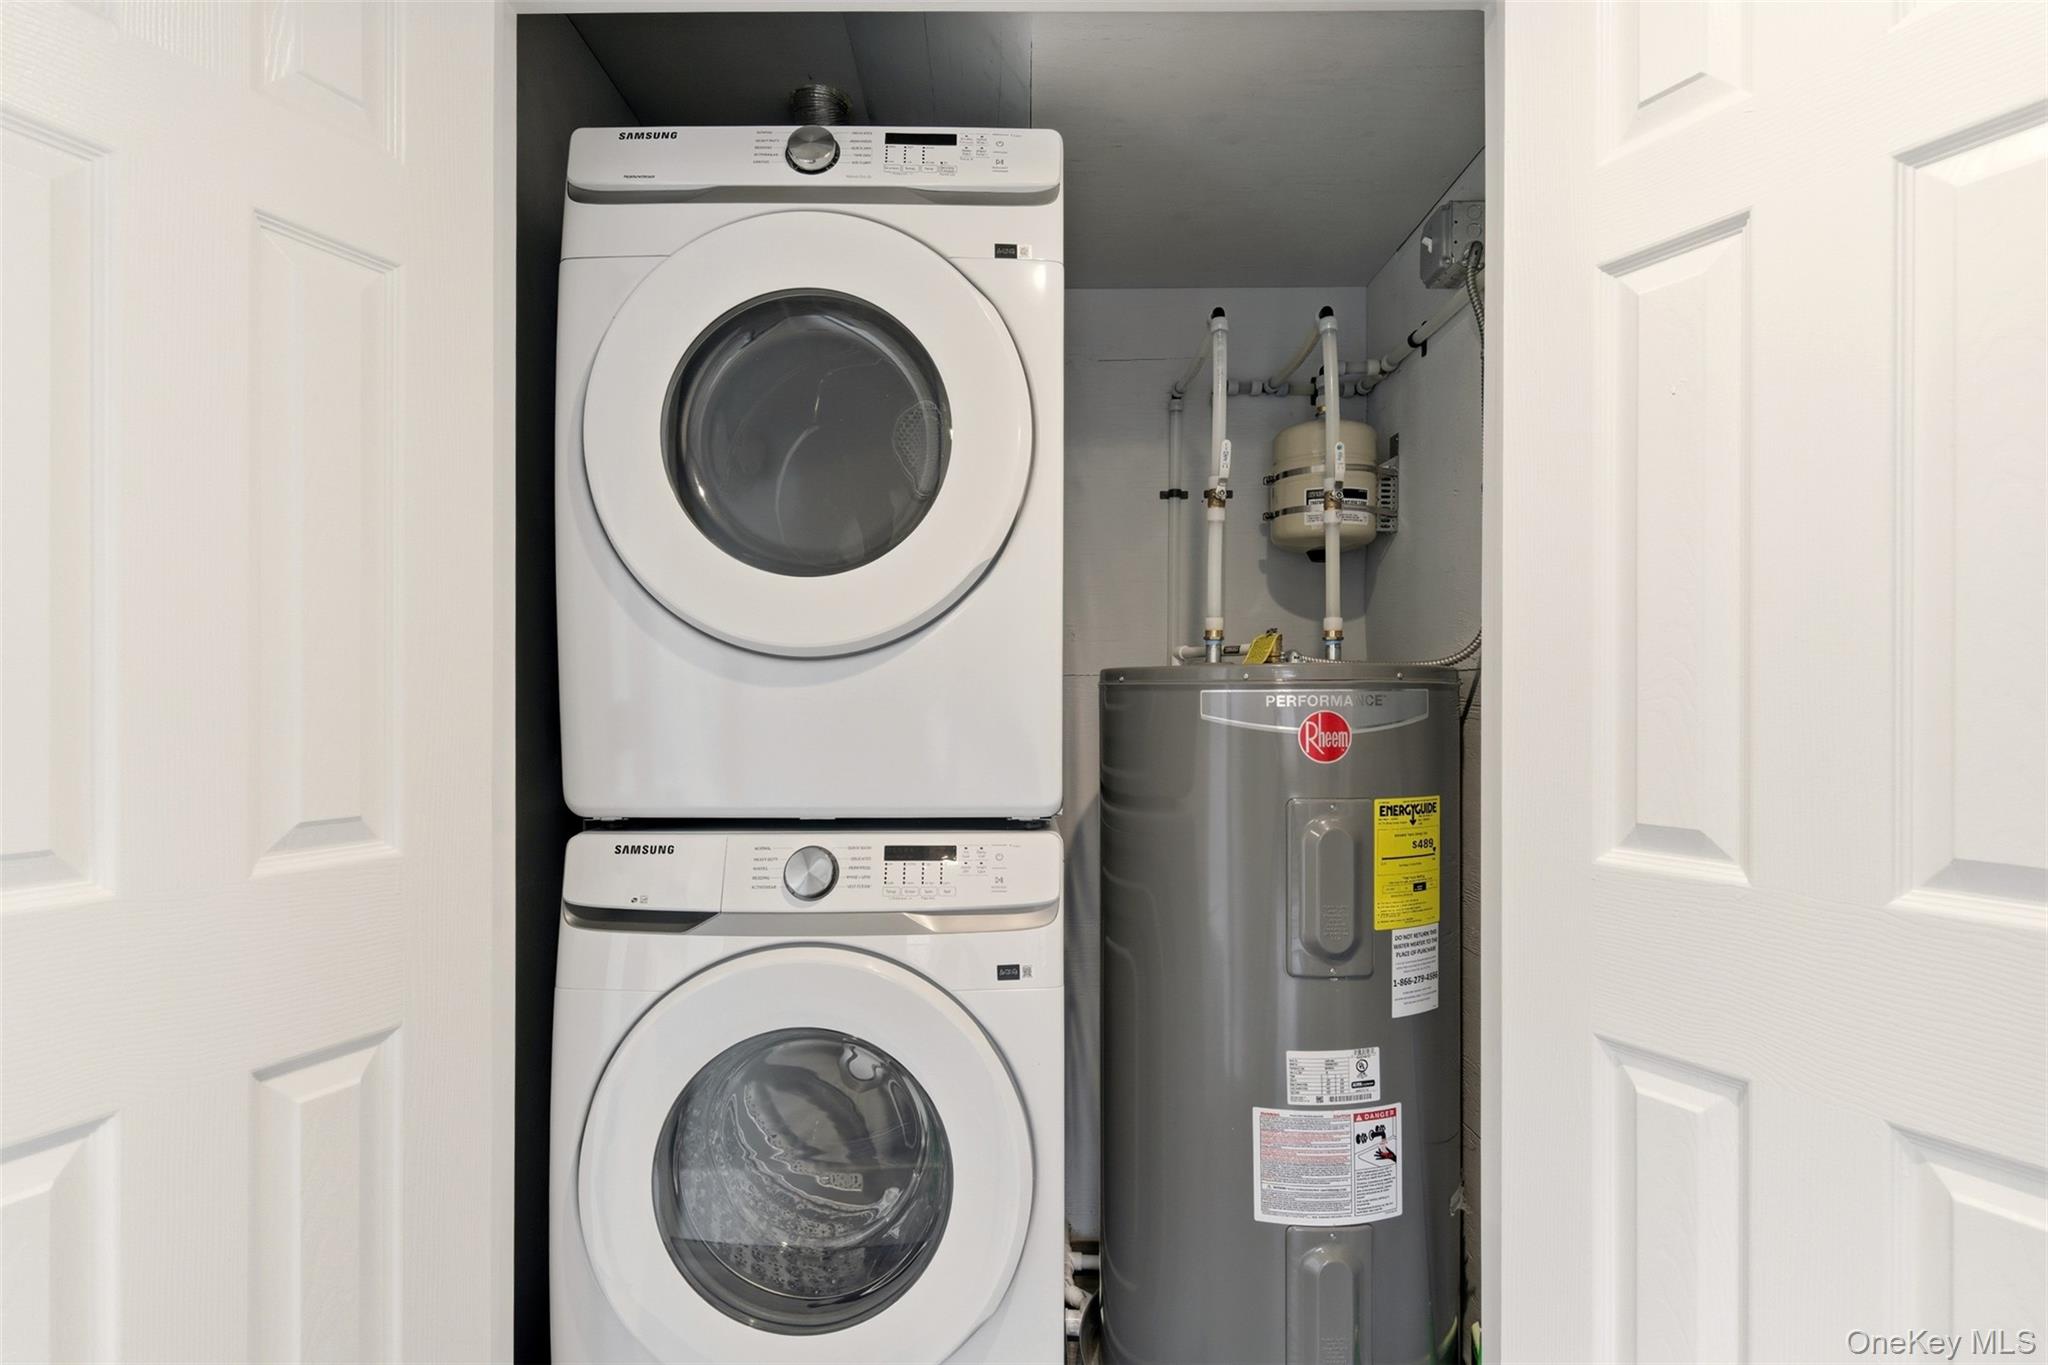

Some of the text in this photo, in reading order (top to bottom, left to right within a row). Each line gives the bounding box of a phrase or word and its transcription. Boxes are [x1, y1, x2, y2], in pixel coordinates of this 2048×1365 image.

[619, 131, 678, 140] SAMSUNG
[1266, 695, 1384, 707] PERFORMANCE
[1305, 713, 1349, 755] Rheem
[1379, 802, 1437, 818] ENERGYGUIDE
[614, 844, 675, 855] SAMSUNG
[1364, 1109, 1395, 1120] DANGER
